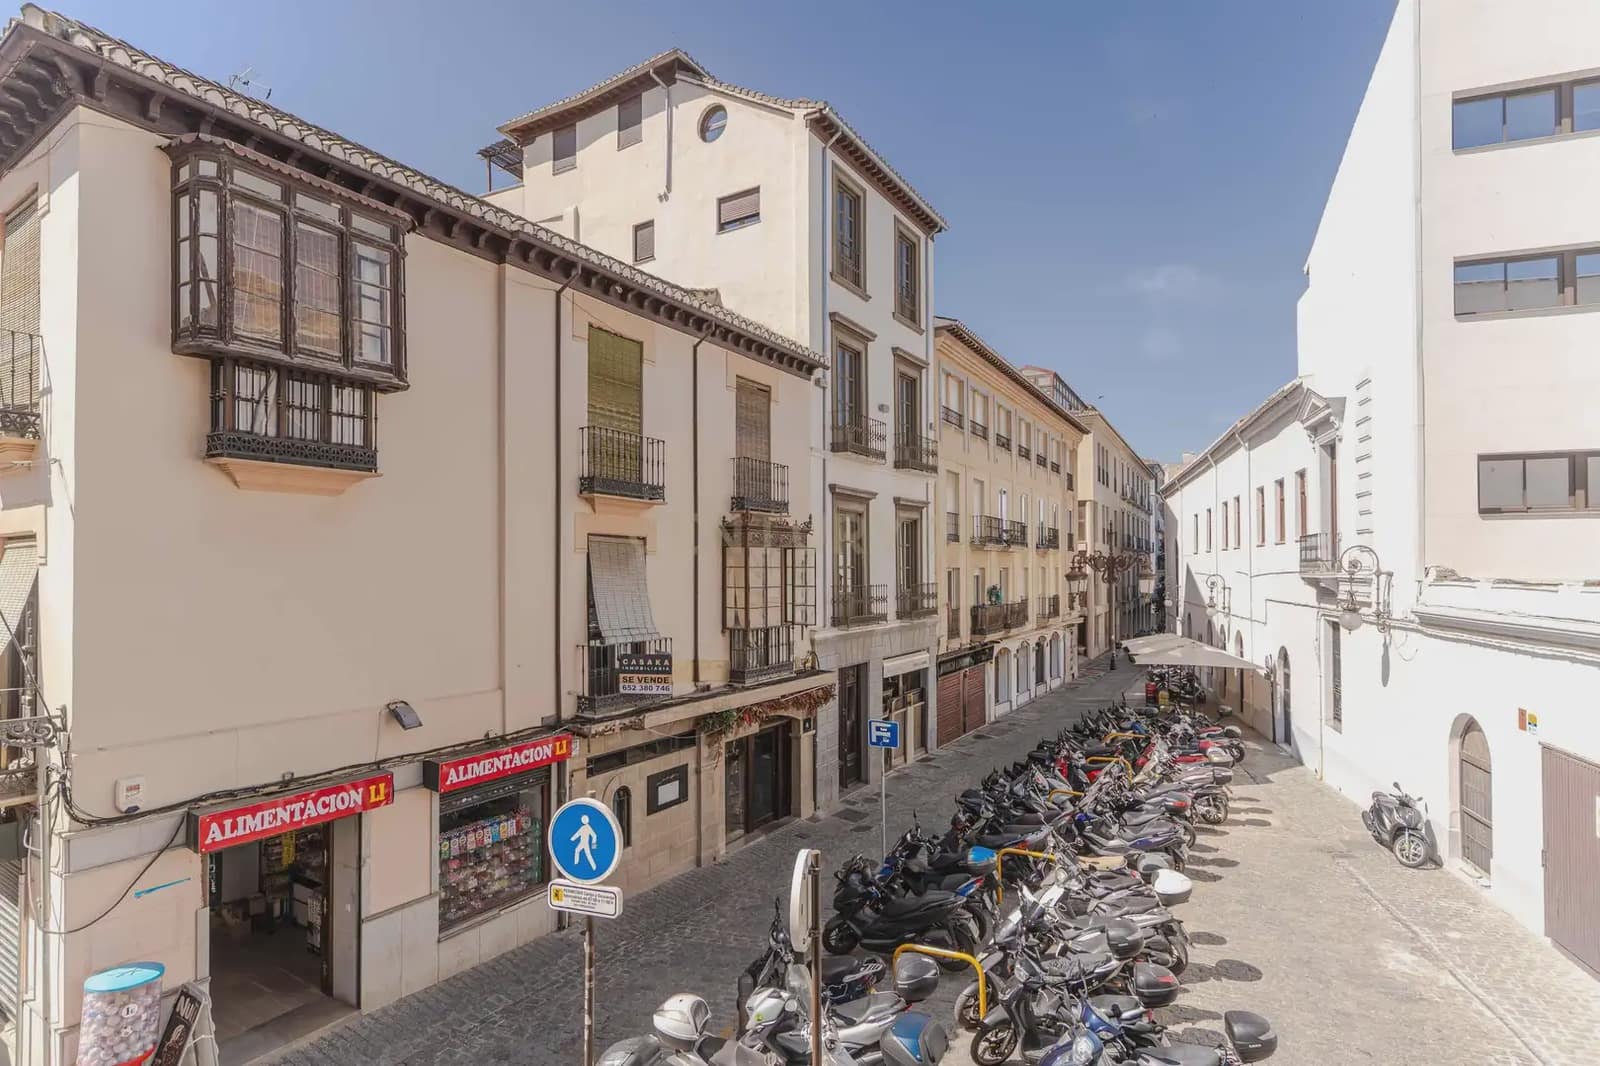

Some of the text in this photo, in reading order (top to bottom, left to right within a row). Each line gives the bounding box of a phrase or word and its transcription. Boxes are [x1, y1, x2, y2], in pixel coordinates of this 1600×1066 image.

[622, 675, 670, 684] SE VENDE
[446, 739, 568, 785] ALIMENTACION LI
[205, 782, 387, 845] ALIMENTACION LI
